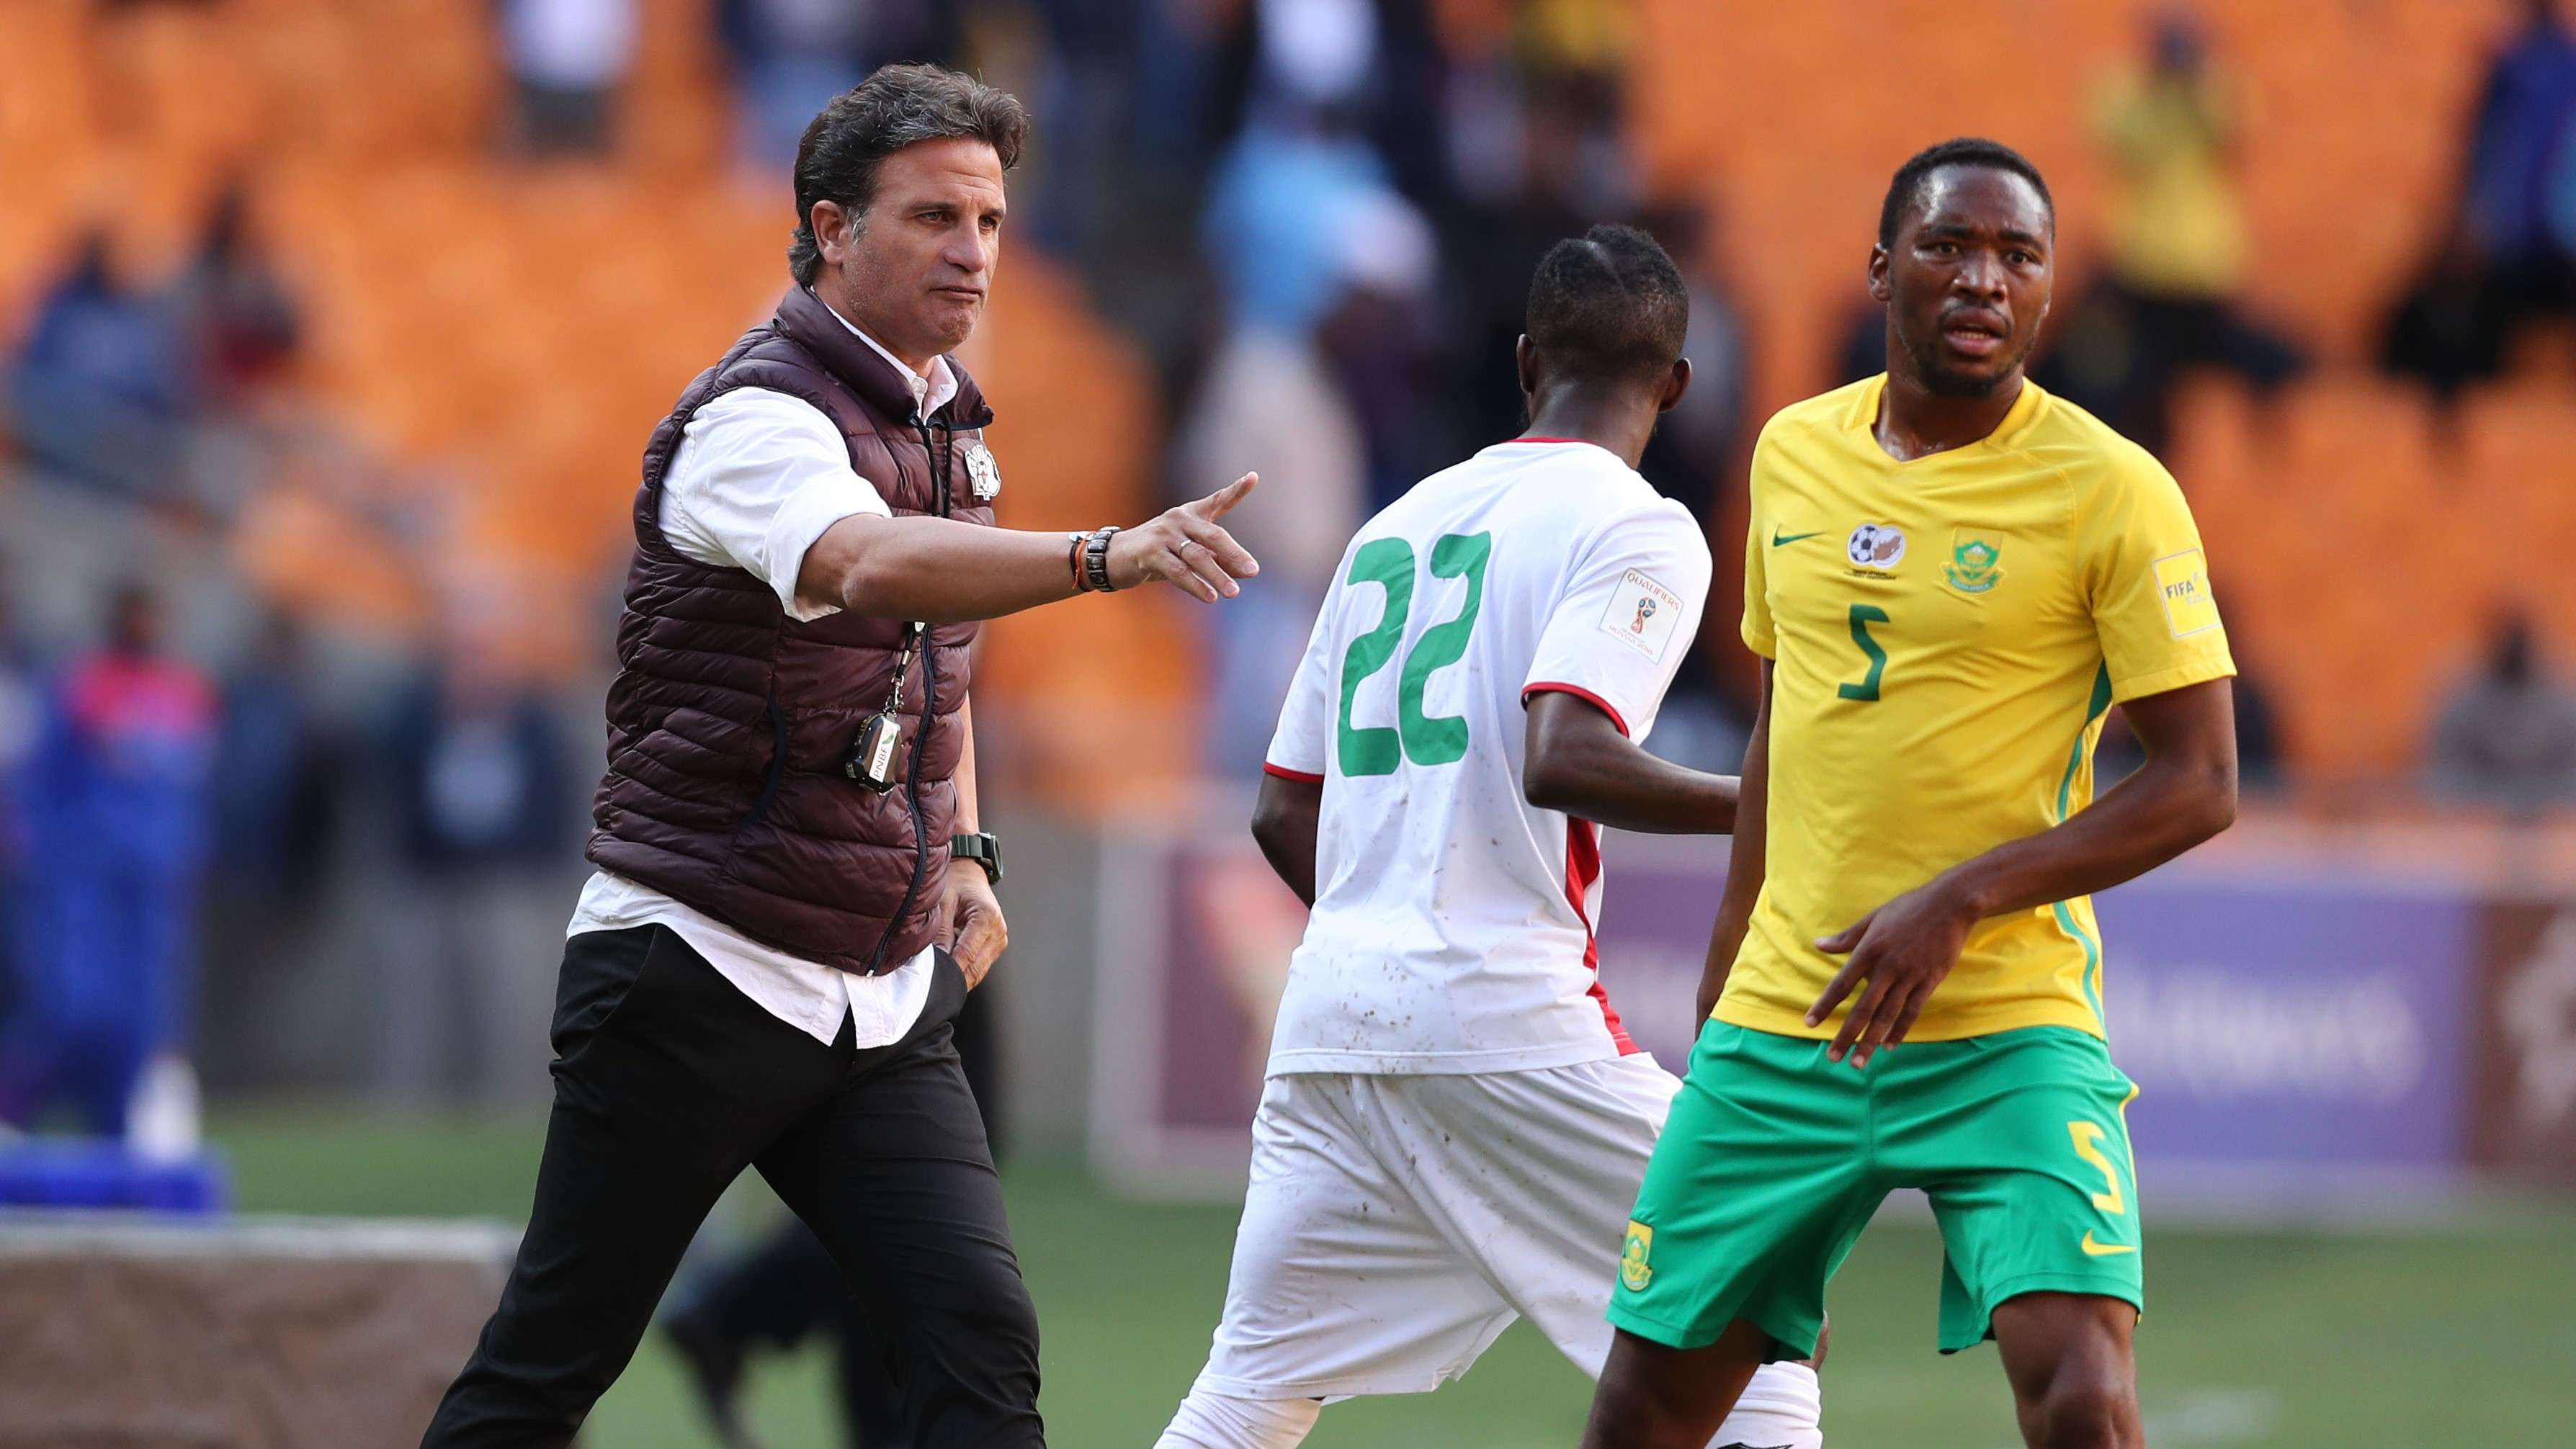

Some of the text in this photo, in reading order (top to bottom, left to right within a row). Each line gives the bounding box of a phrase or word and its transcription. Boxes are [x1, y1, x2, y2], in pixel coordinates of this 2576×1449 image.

[1627, 572, 1680, 610] QUALIFIERS
[2165, 580, 2195, 599] FIFA
[1338, 530, 1491, 777] 22
[1838, 604, 1890, 701] 5
[2067, 1121, 2124, 1215] 5
